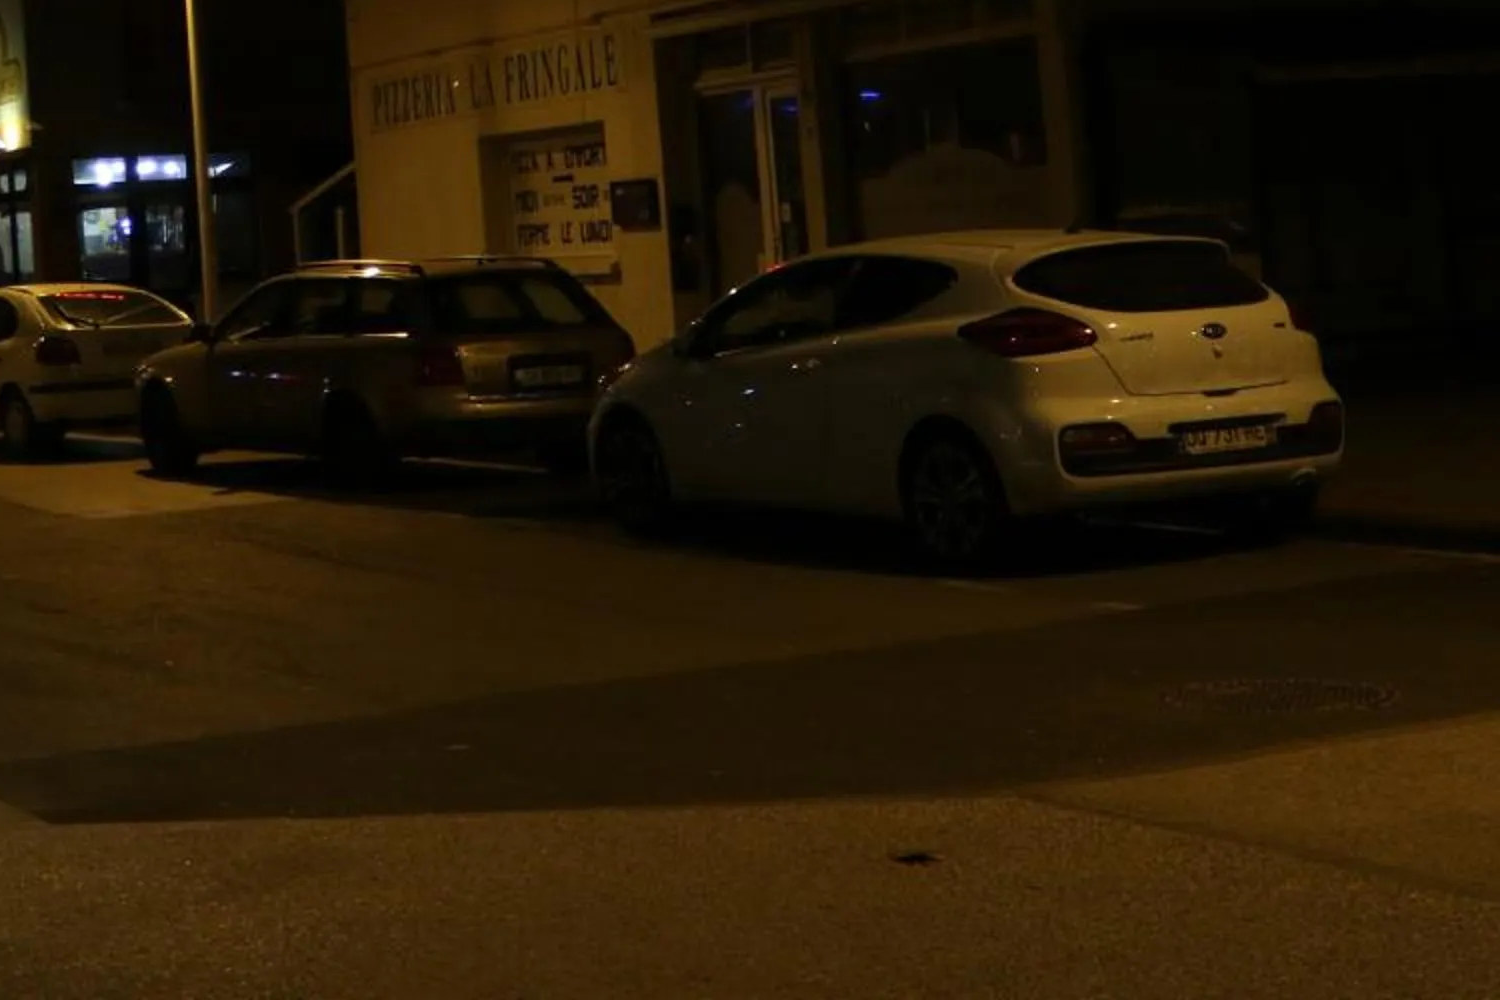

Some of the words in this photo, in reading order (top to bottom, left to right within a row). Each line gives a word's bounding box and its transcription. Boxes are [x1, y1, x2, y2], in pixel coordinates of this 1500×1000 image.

[372, 72, 456, 127] PIZZERIA
[468, 61, 496, 109] LA
[504, 34, 618, 104] FRINGALE
